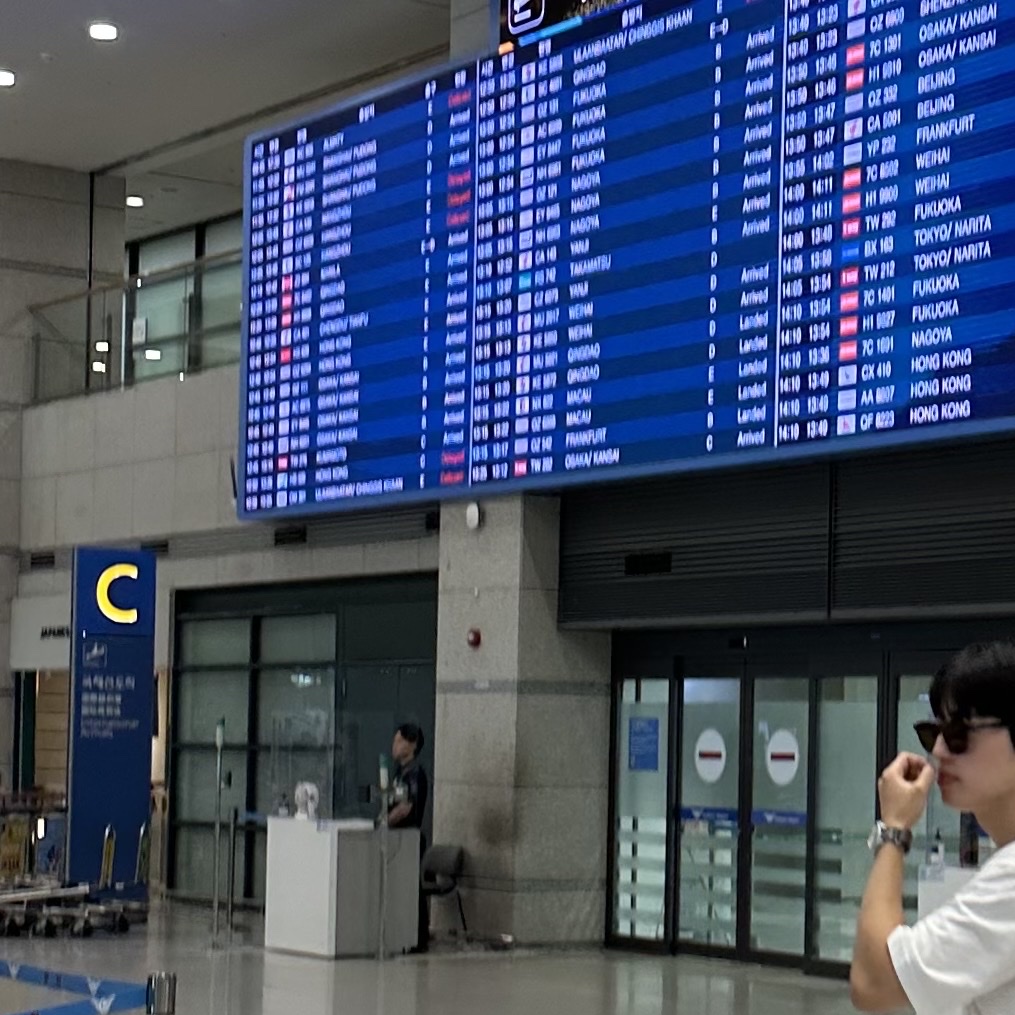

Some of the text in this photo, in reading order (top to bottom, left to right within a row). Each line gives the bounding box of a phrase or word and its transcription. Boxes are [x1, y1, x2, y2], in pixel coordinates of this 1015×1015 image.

[915, 146, 950, 169] WEIHAI
[915, 172, 949, 195] WEIHAI
[914, 195, 961, 220] FUKUOKA
[914, 221, 952, 245] TOKYO/
[914, 247, 951, 271] TOKYO/
[913, 273, 959, 296] FUKUOKA
[912, 299, 958, 322] FUKUOKA
[911, 326, 952, 347] NAGOYA
[911, 353, 940, 372] HONG
[942, 347, 971, 368] KONG
[910, 378, 939, 398] HONG
[941, 374, 971, 393] KONG
[909, 404, 939, 424] HONG
[941, 399, 970, 419] KONG
[97, 564, 138, 623] C
